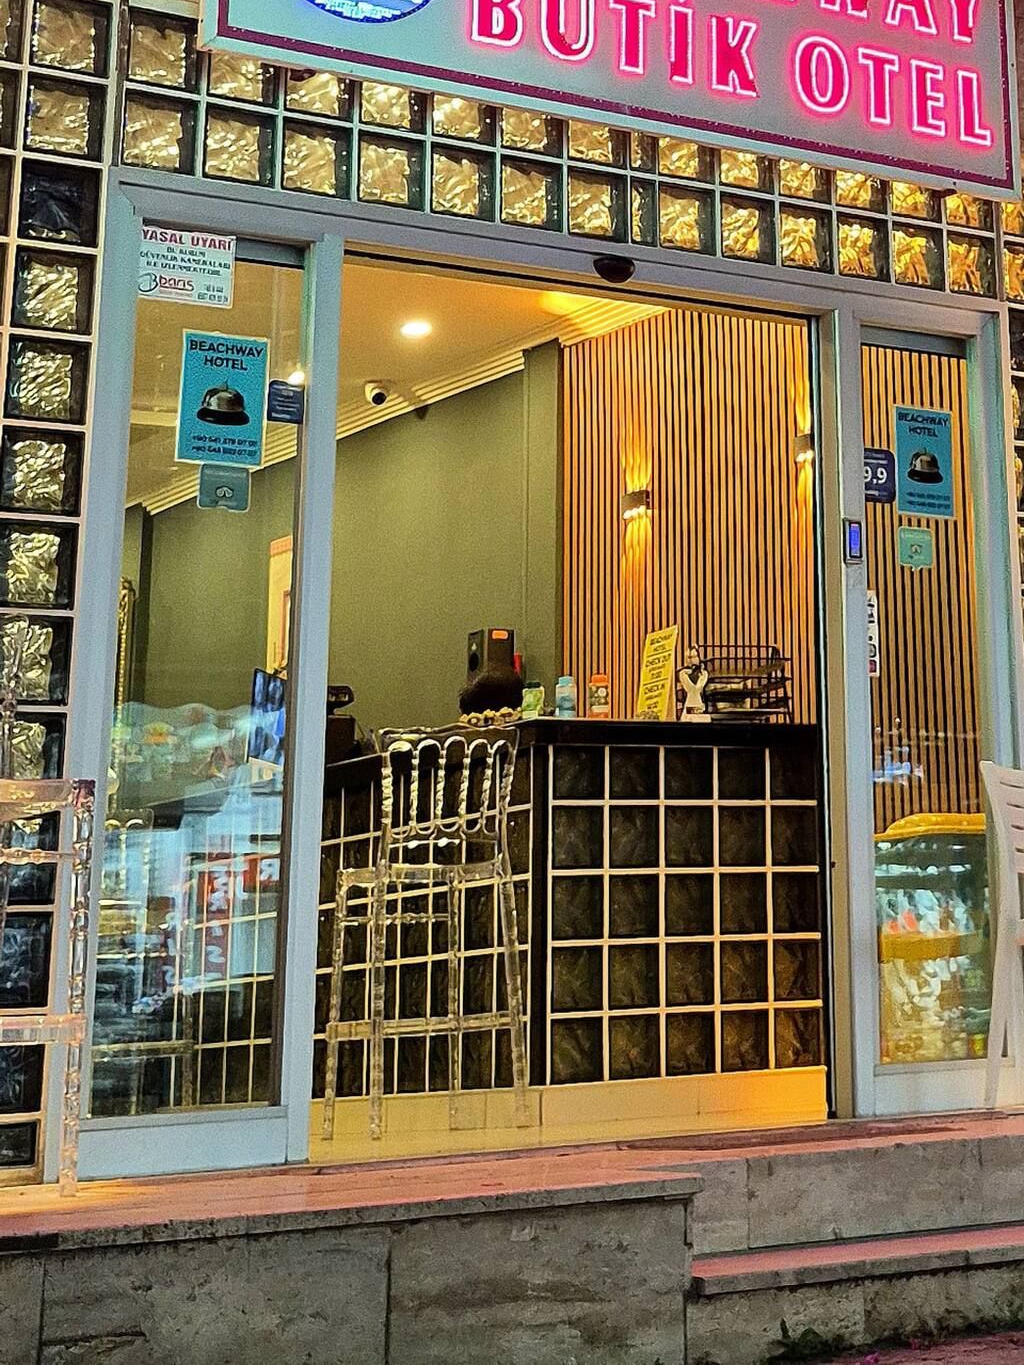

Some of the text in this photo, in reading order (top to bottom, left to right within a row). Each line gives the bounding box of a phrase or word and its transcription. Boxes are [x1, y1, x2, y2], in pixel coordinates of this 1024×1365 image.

[795, 35, 992, 146] OTEL
[142, 228, 186, 245] YASAL
[190, 339, 264, 358] BEACHWAY
[203, 354, 248, 372] HOTEL
[908, 425, 939, 438] HOTEL
